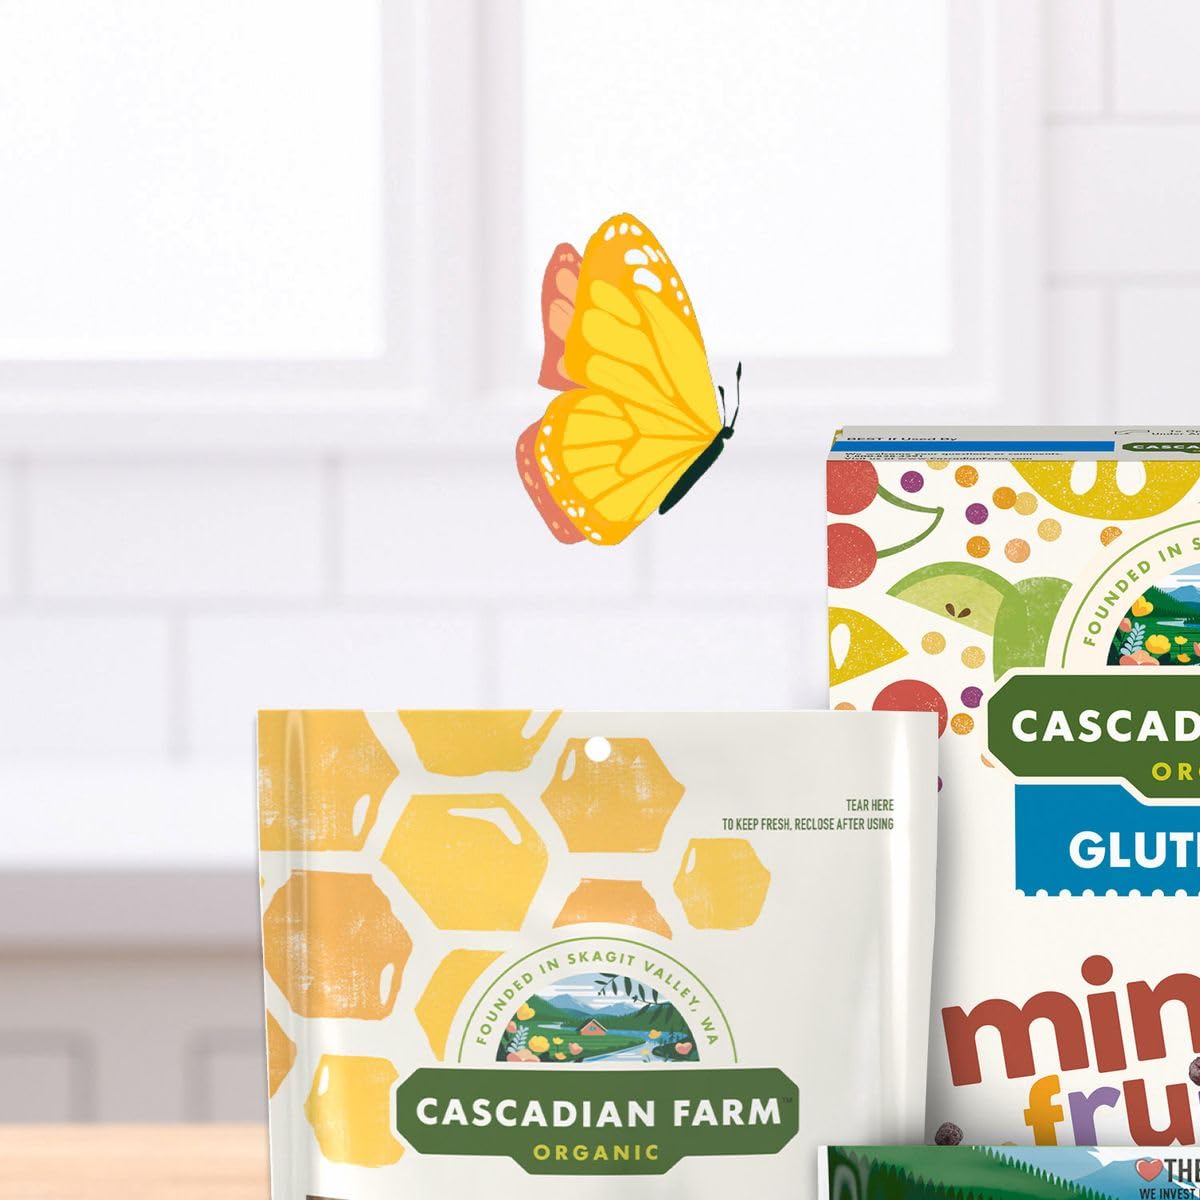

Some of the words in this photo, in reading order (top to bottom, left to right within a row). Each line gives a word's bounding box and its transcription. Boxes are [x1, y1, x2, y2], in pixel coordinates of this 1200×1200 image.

[1083, 560, 1151, 647] FOUNDED
[1158, 543, 1182, 562] IN
[846, 799, 869, 811] TEAR
[872, 799, 894, 811] HERE
[722, 818, 733, 830] TO
[736, 818, 759, 830] KEEP
[761, 818, 792, 831] FRESH,
[795, 818, 834, 830] RECLOSE
[836, 818, 864, 830] AFTER
[867, 818, 894, 830] USING
[476, 972, 533, 1045] FOUNDED
[539, 958, 560, 974] IN
[567, 951, 636, 965] SKAGIT
[643, 961, 700, 1012] VALLEY,
[700, 1016, 719, 1045] WA
[416, 1097, 656, 1128] CASCADIAN
[533, 1144, 659, 1161] ORGANIC
[1140, 1188, 1155, 1200] WE
[1159, 1188, 1195, 1200] INVEST
